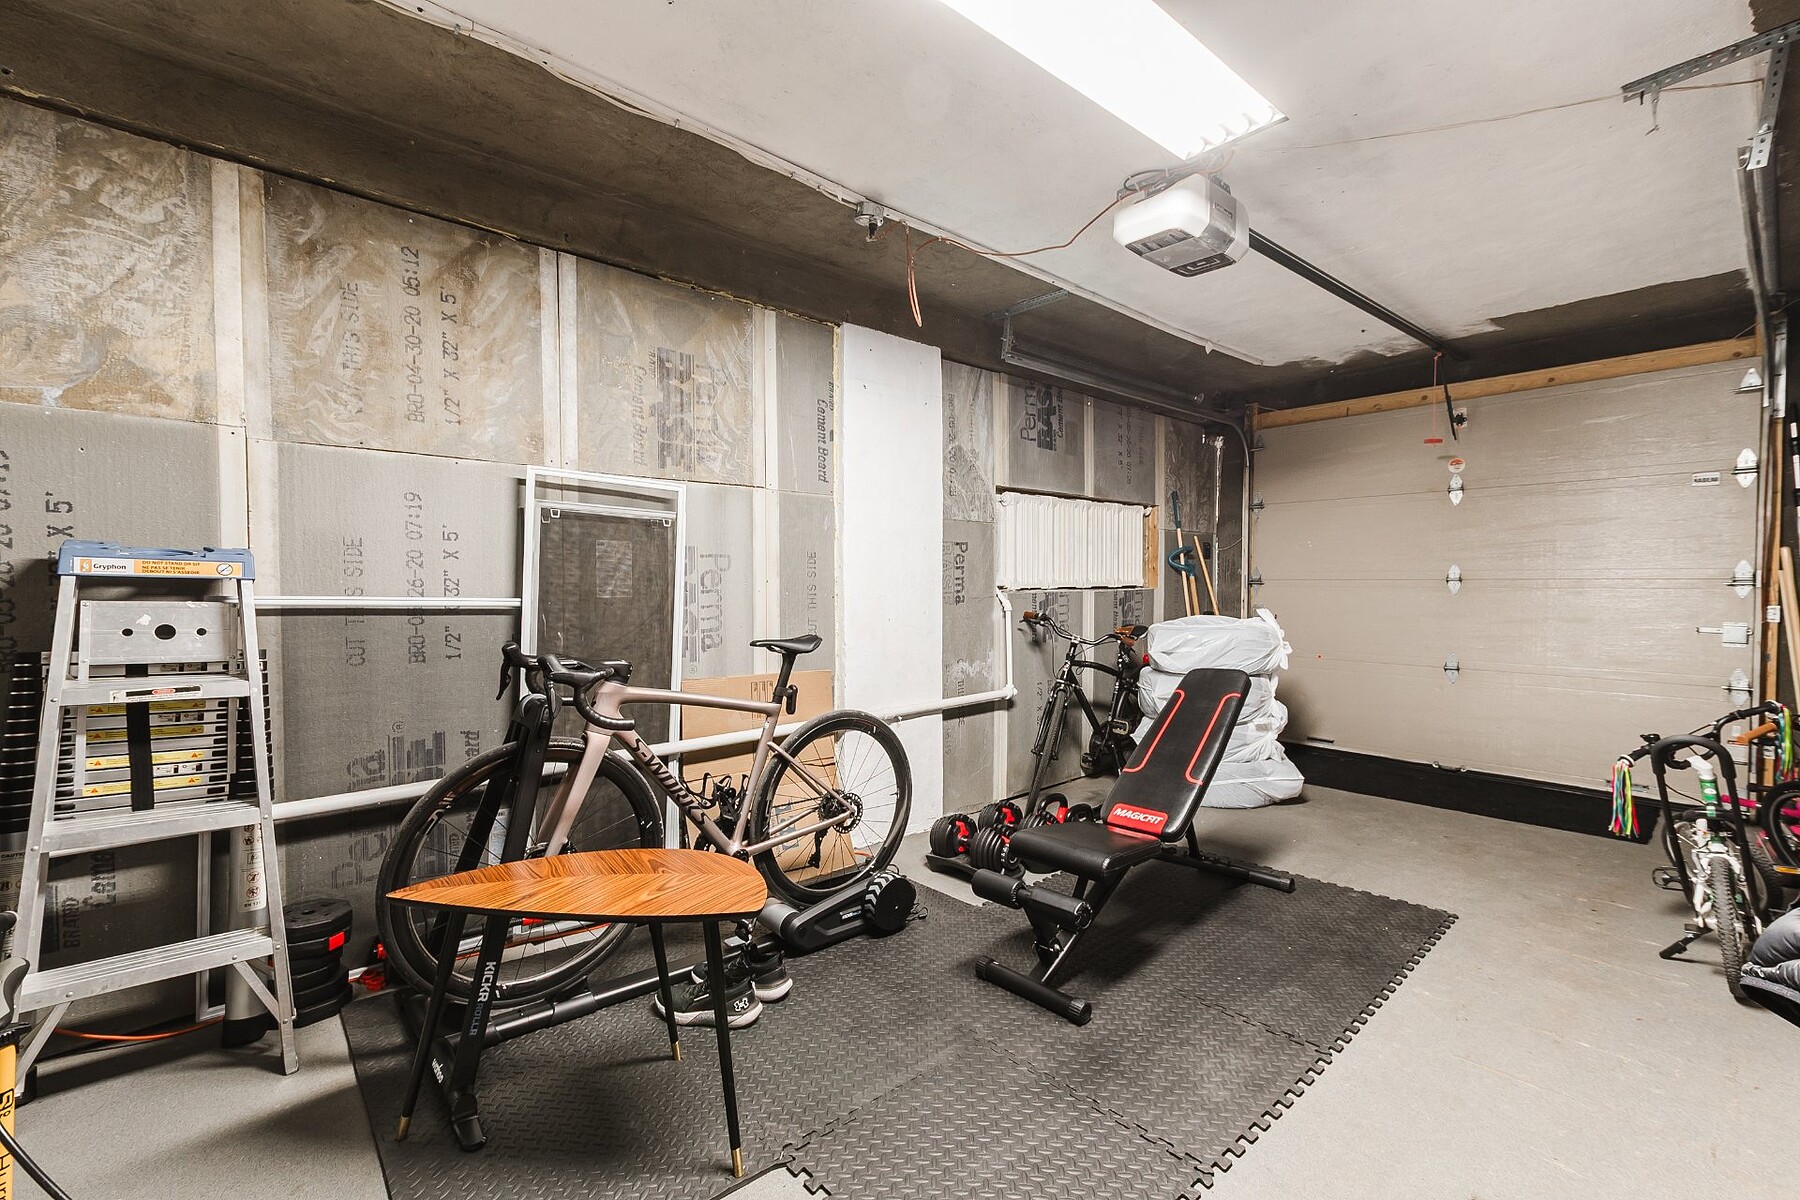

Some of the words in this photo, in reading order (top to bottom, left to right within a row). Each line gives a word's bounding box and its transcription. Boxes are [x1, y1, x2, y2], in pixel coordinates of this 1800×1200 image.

[400, 246, 421, 297] 05:12
[440, 310, 458, 325] X
[816, 399, 829, 445] Cement
[817, 446, 830, 484] Board
[403, 490, 423, 542] 07:19
[93, 563, 127, 571] Gryphon
[342, 535, 364, 578] SIDE
[443, 549, 460, 560] X
[953, 541, 969, 607] Perma
[700, 553, 732, 655] Perma
[345, 636, 366, 668] CUT
[443, 625, 461, 661] 1/2"
[61, 896, 80, 949] BRAND
[477, 961, 498, 1003] KICKR
